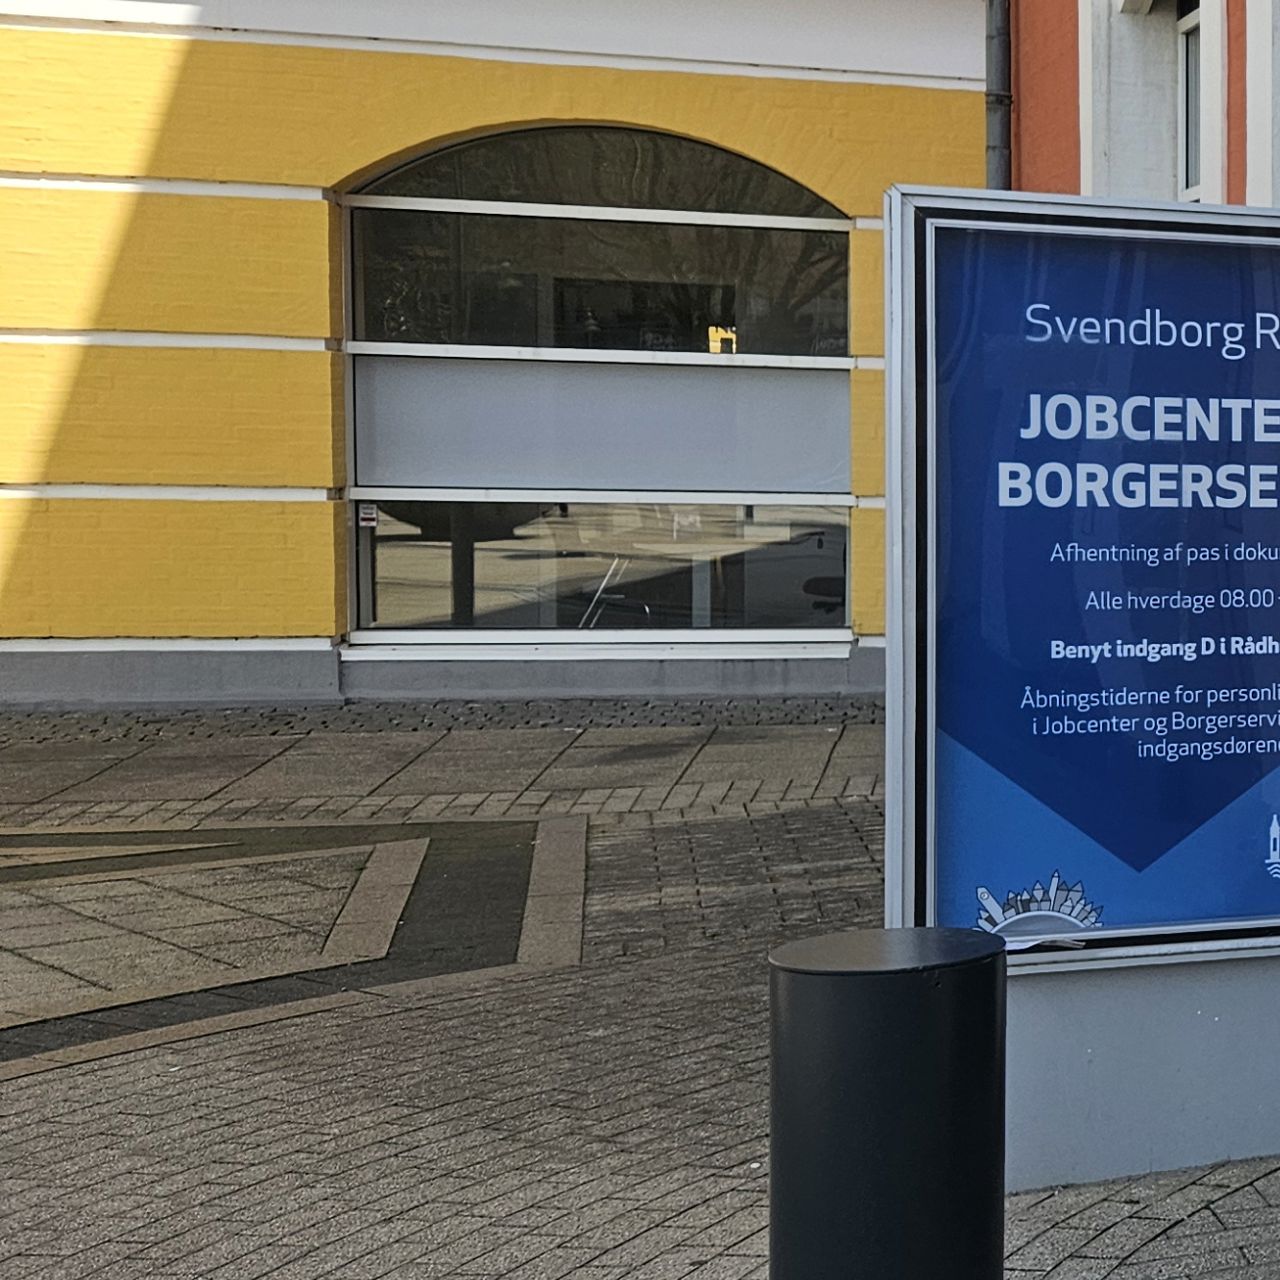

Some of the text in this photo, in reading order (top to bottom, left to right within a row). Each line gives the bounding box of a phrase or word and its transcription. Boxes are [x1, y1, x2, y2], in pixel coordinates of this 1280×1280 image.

[1025, 303, 1246, 360] Svendborg
[1050, 542, 1160, 567] Afhentning
[1163, 541, 1183, 561] af
[1187, 547, 1221, 567] pas
[1224, 543, 1229, 561] i
[1085, 590, 1123, 610] Alle
[1127, 590, 1215, 614] hverdage
[1219, 588, 1275, 608] 08.00
[1050, 639, 1112, 664] Benyt
[1115, 638, 1197, 662] indgang
[1201, 637, 1216, 656] D
[1219, 637, 1227, 655] i
[1020, 685, 1171, 712] Åbningstiderne
[1174, 684, 1204, 704] for
[1032, 717, 1038, 735] i
[1042, 715, 1140, 735] Jobcenter
[1143, 718, 1168, 736] og
